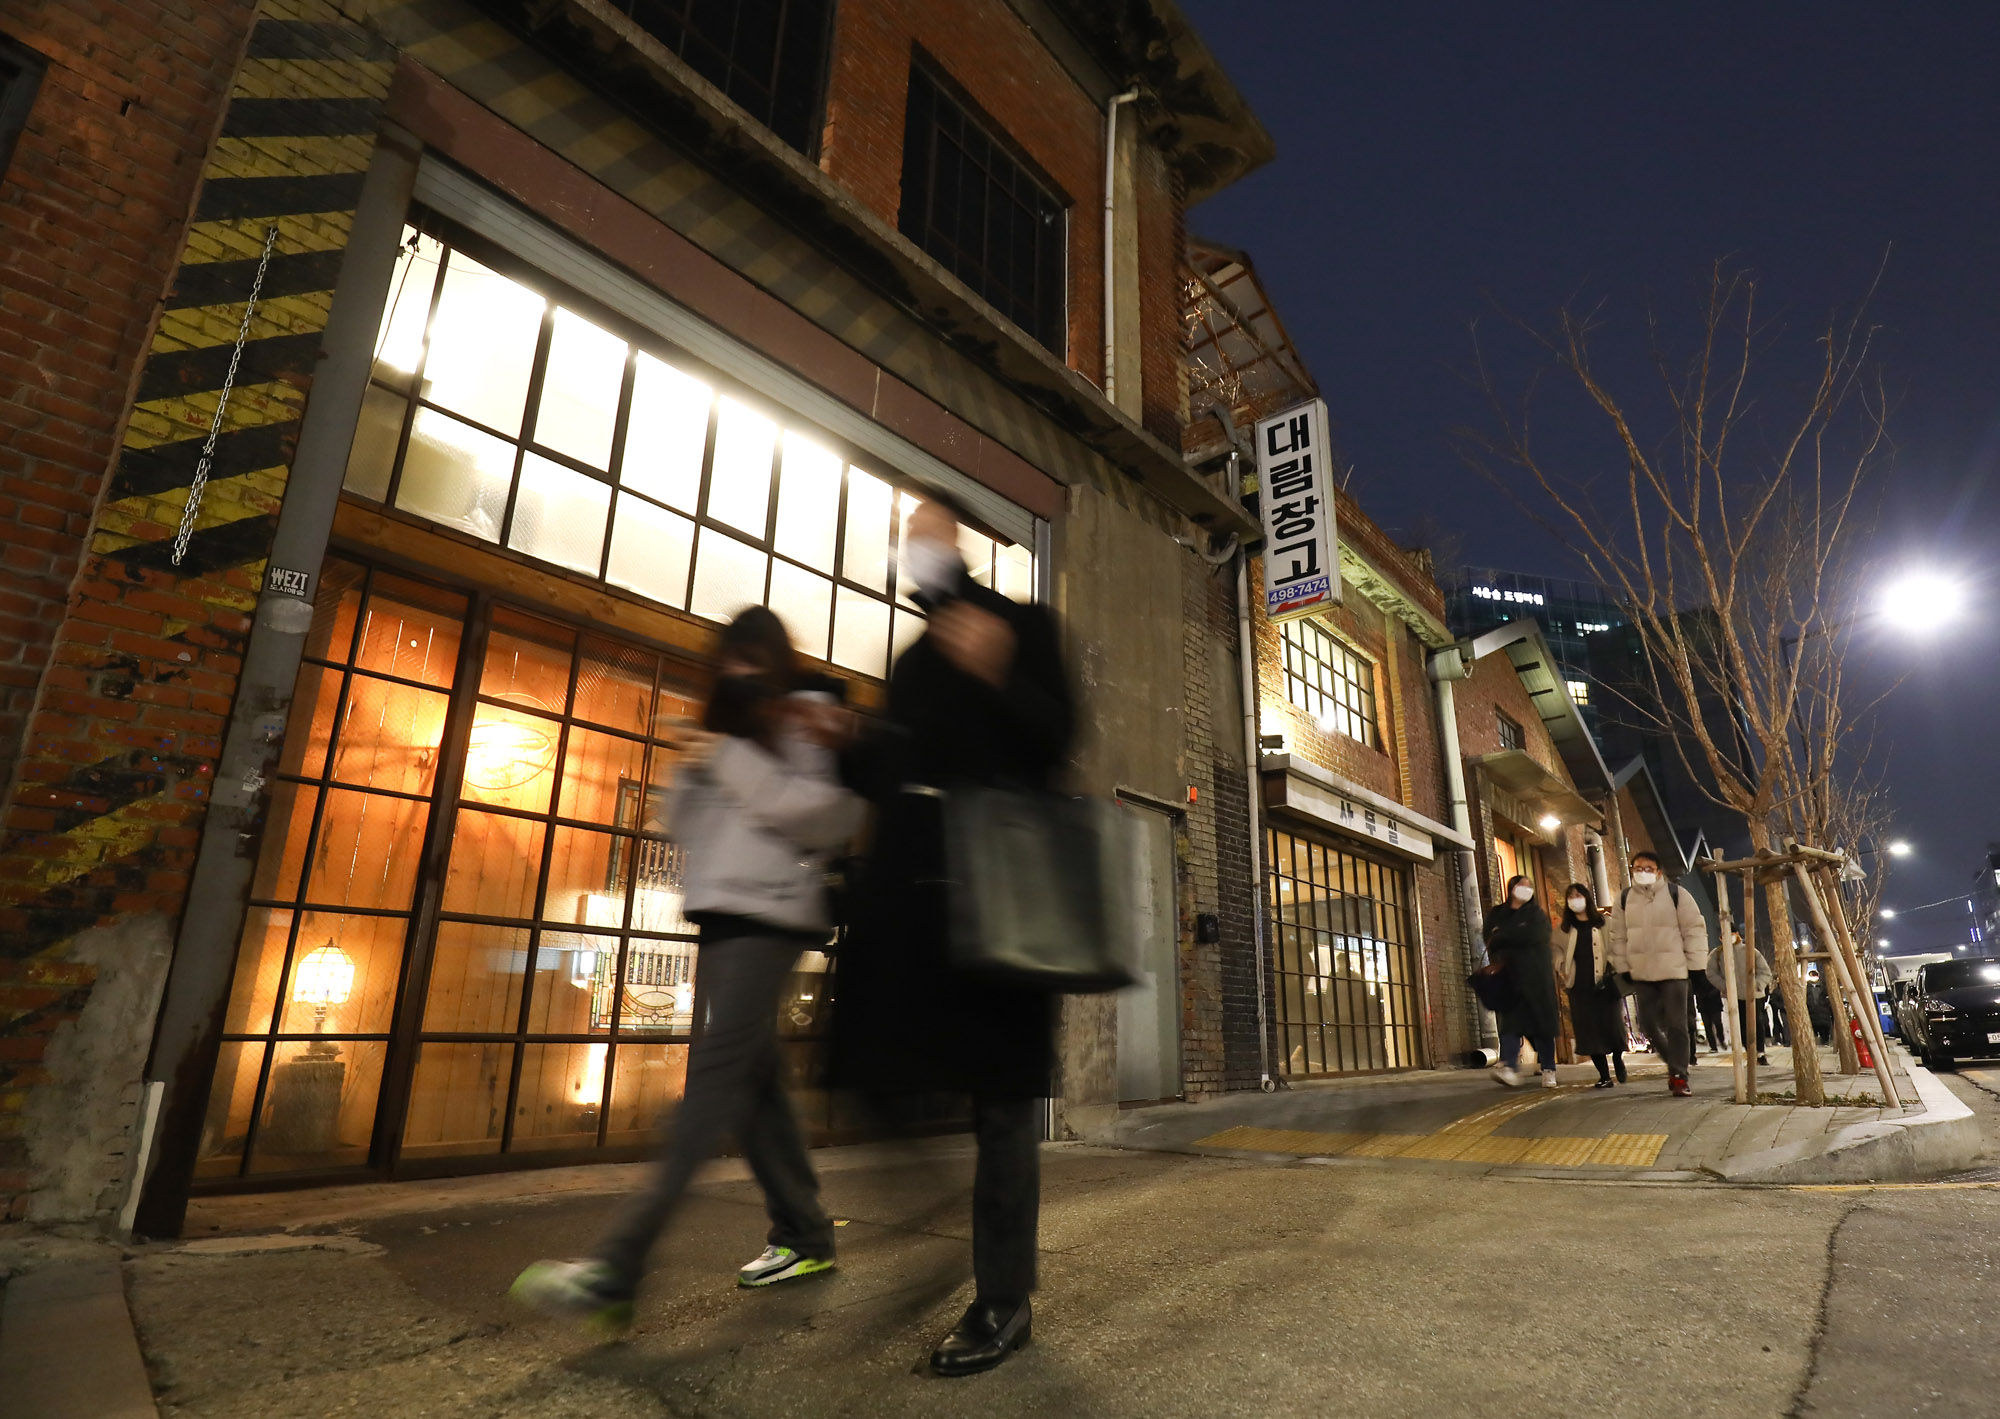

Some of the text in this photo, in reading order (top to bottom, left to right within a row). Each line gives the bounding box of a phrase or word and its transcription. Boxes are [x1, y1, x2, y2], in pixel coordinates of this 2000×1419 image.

[1266, 413, 1321, 586] 대림창고
[1269, 577, 1328, 604] 498-7474
[1340, 800, 1399, 845] 사무실
